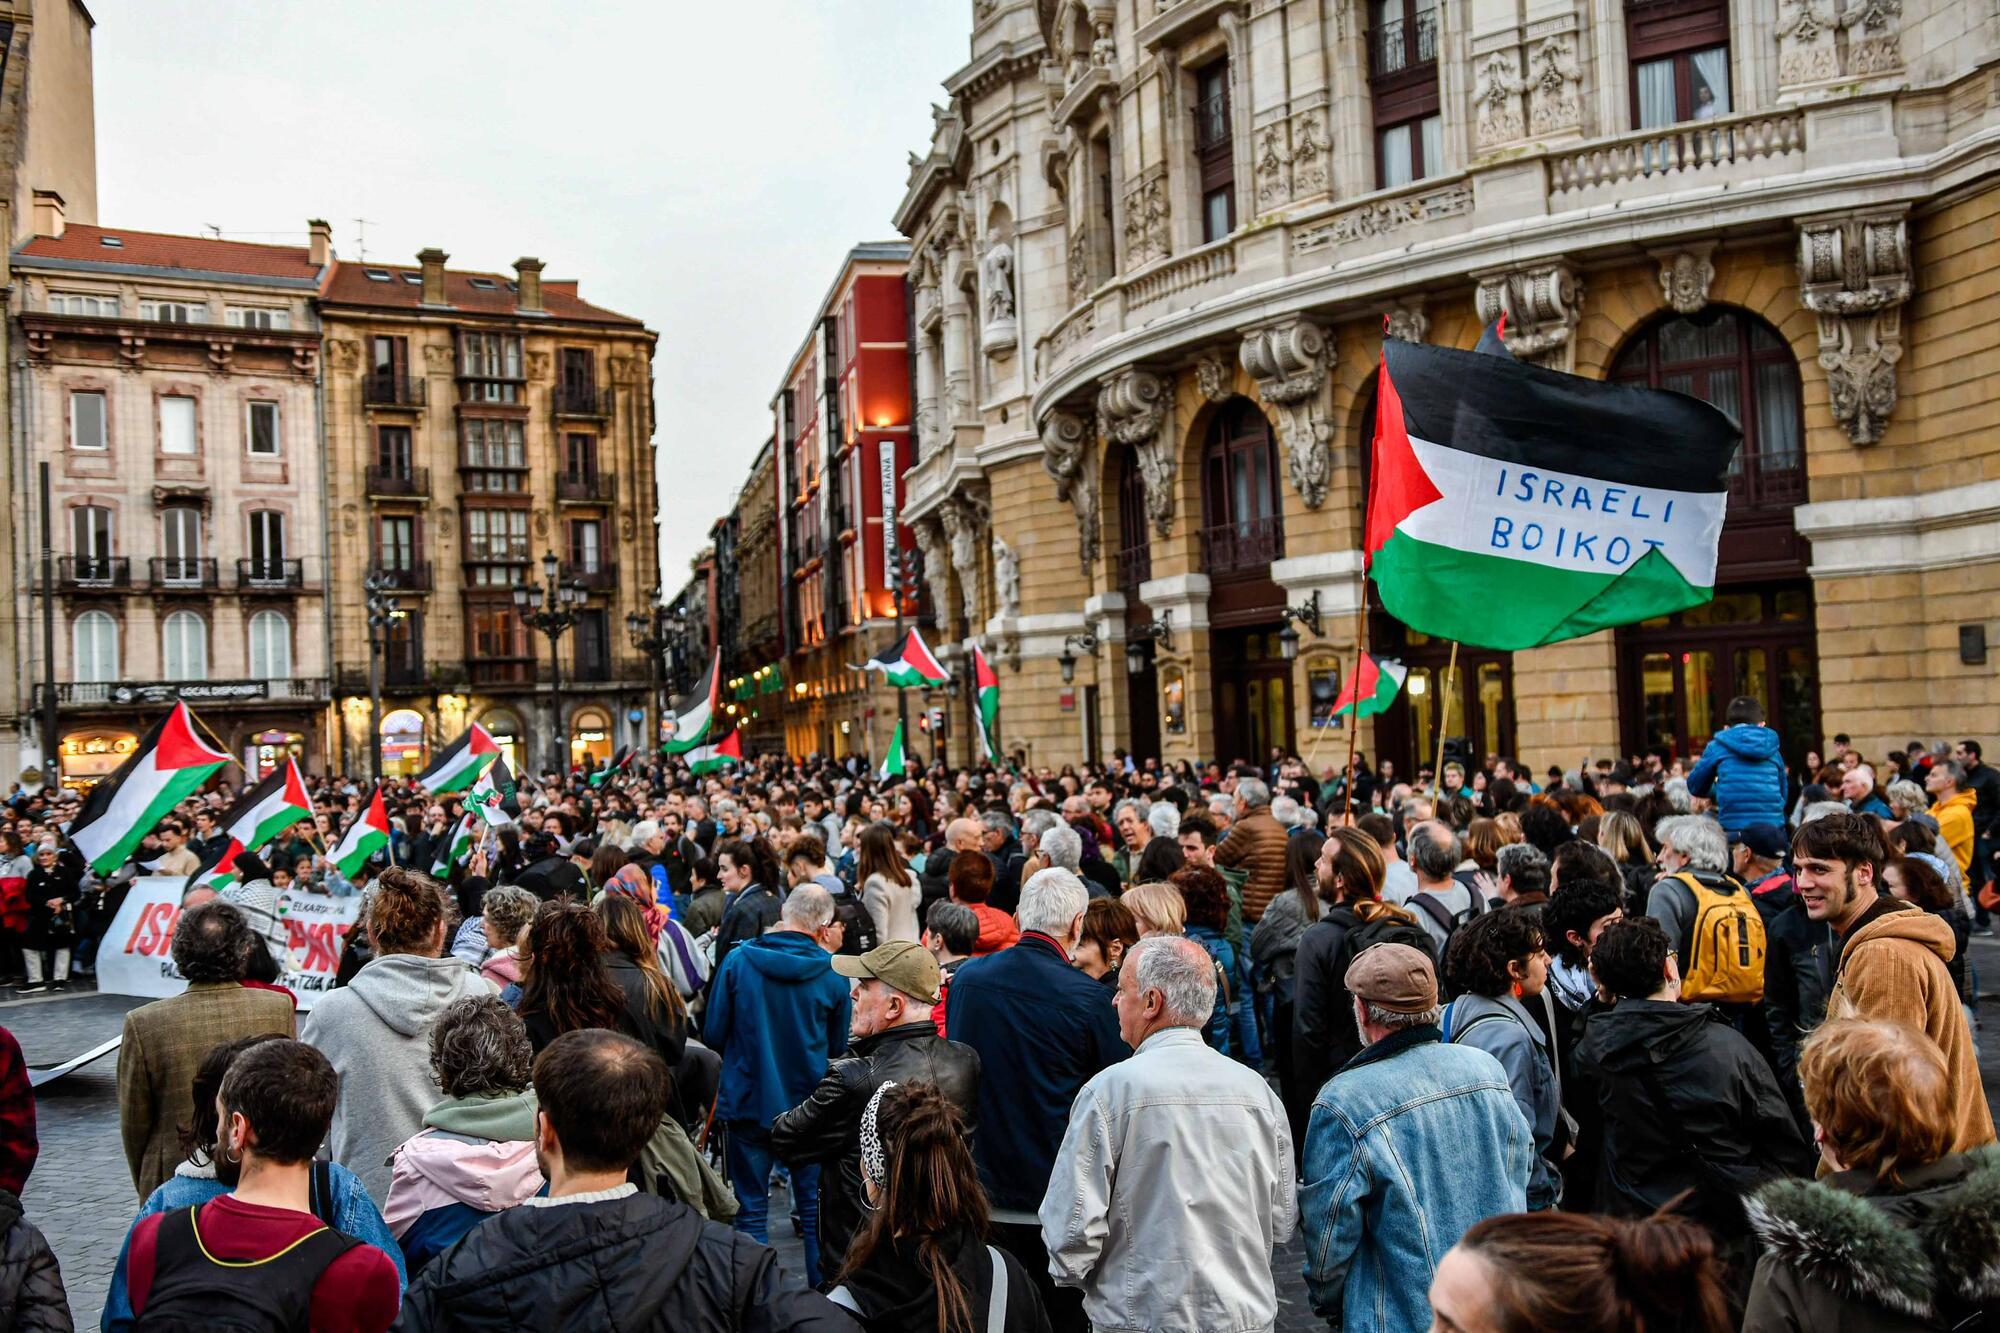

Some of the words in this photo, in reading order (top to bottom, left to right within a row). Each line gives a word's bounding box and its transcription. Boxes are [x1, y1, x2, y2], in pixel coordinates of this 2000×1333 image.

[882, 457, 892, 495] ARANA
[1497, 469, 1674, 523] ISRAELI
[179, 686, 211, 697] LOCAL
